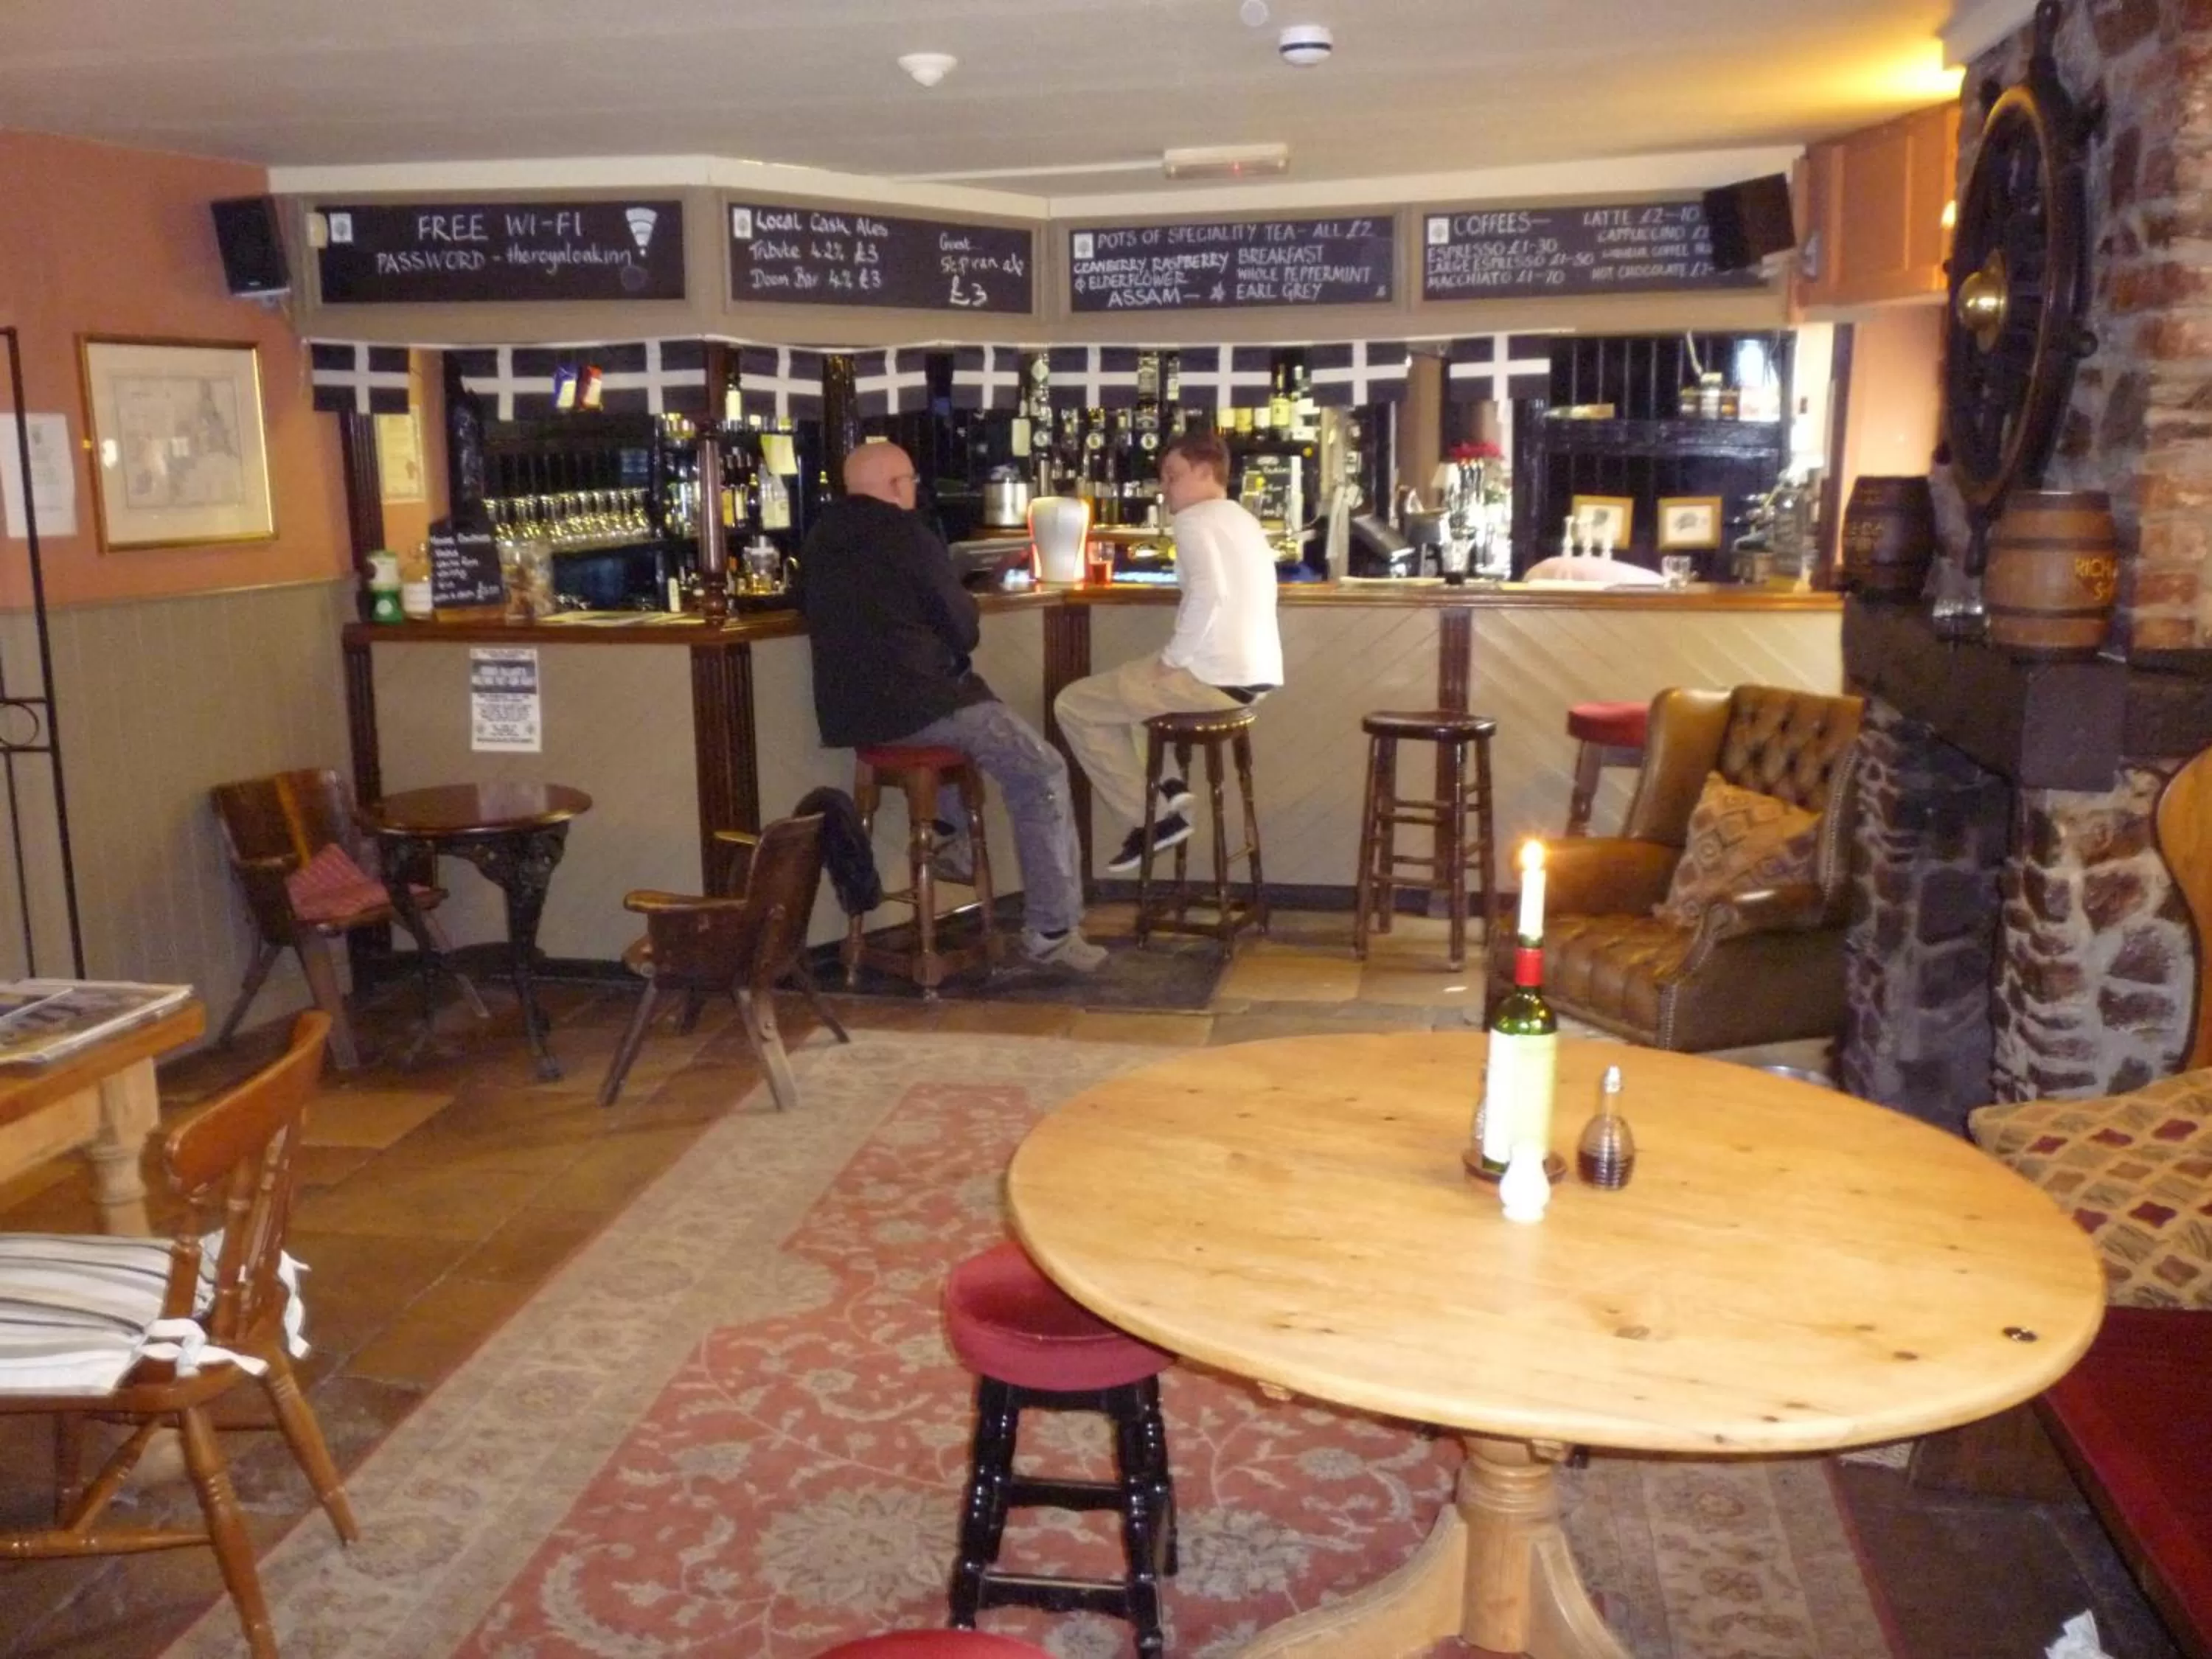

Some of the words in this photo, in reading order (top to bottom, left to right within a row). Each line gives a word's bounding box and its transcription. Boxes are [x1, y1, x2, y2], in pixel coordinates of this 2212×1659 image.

[417, 213, 488, 241] FREE
[504, 212, 582, 236] WI-FI
[1097, 229, 1137, 249] POTS
[1142, 229, 1161, 245] OF
[1168, 223, 1257, 243] SPECIALITY
[1312, 223, 1341, 239] ALL
[376, 248, 485, 274] PASSWORD
[1238, 244, 1324, 265] BREAKFAST
[1284, 265, 1372, 284] PEPPERMINT
[949, 274, 988, 307] £3
[1107, 287, 1180, 307] ASSAM
[1236, 283, 1277, 300] EARL
[1281, 282, 1324, 302] GREY
